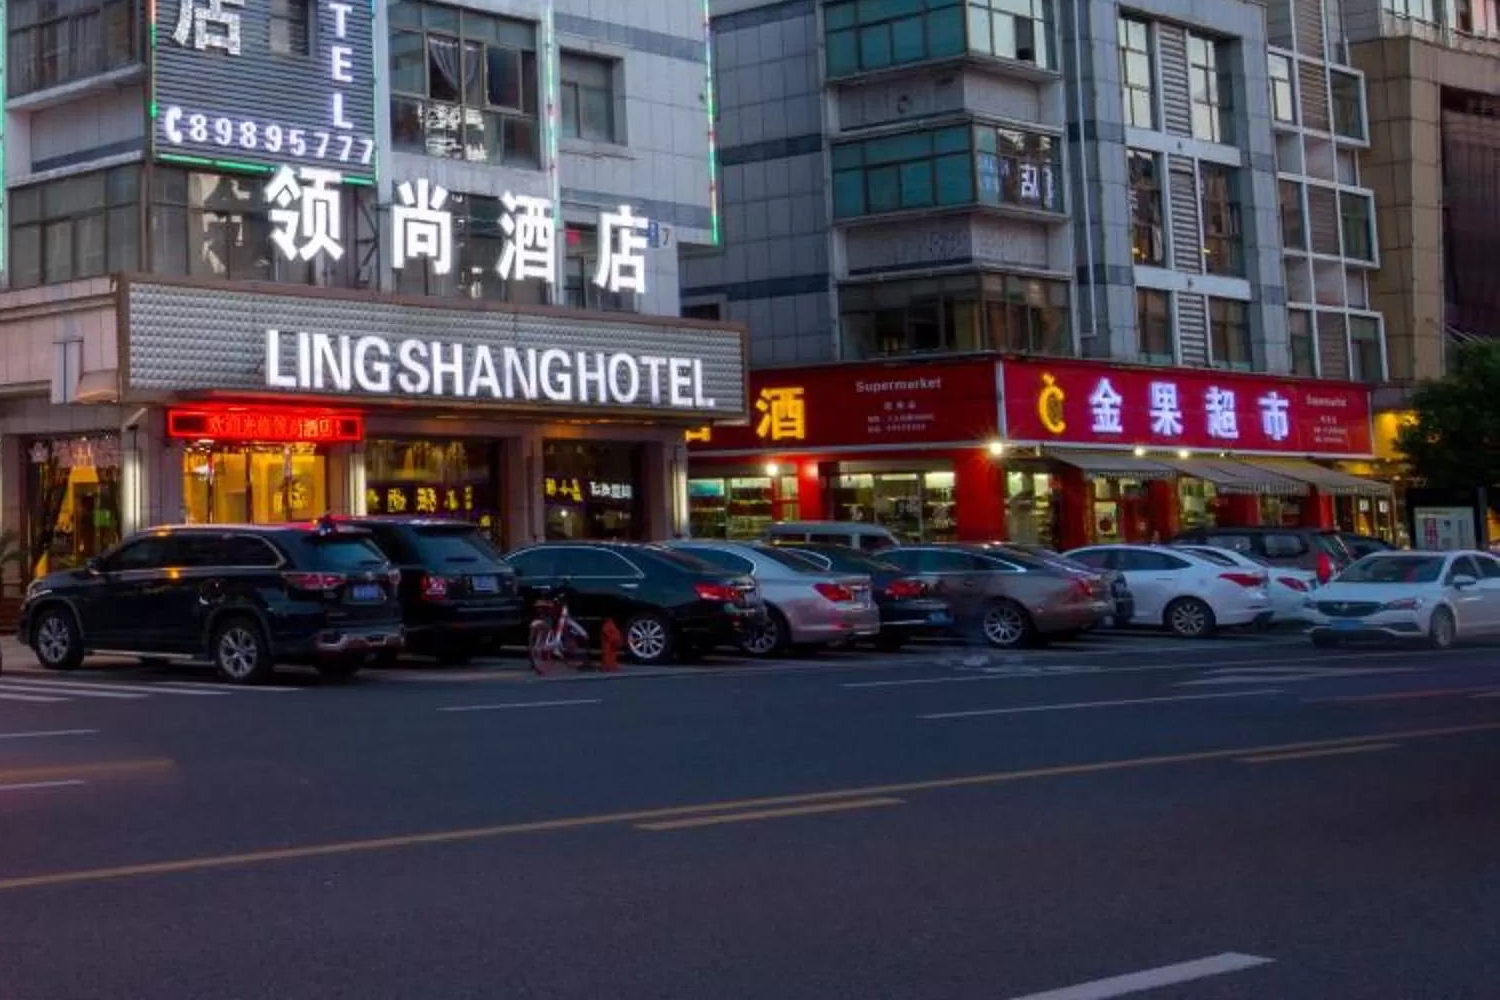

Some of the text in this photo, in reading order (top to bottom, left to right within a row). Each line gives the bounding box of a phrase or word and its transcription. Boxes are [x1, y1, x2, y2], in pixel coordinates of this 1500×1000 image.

[189, 113, 373, 165] 89895777
[265, 164, 649, 294] 领尚酒店
[855, 376, 942, 394] Supermarket
[1088, 377, 1291, 441] 金果超市
